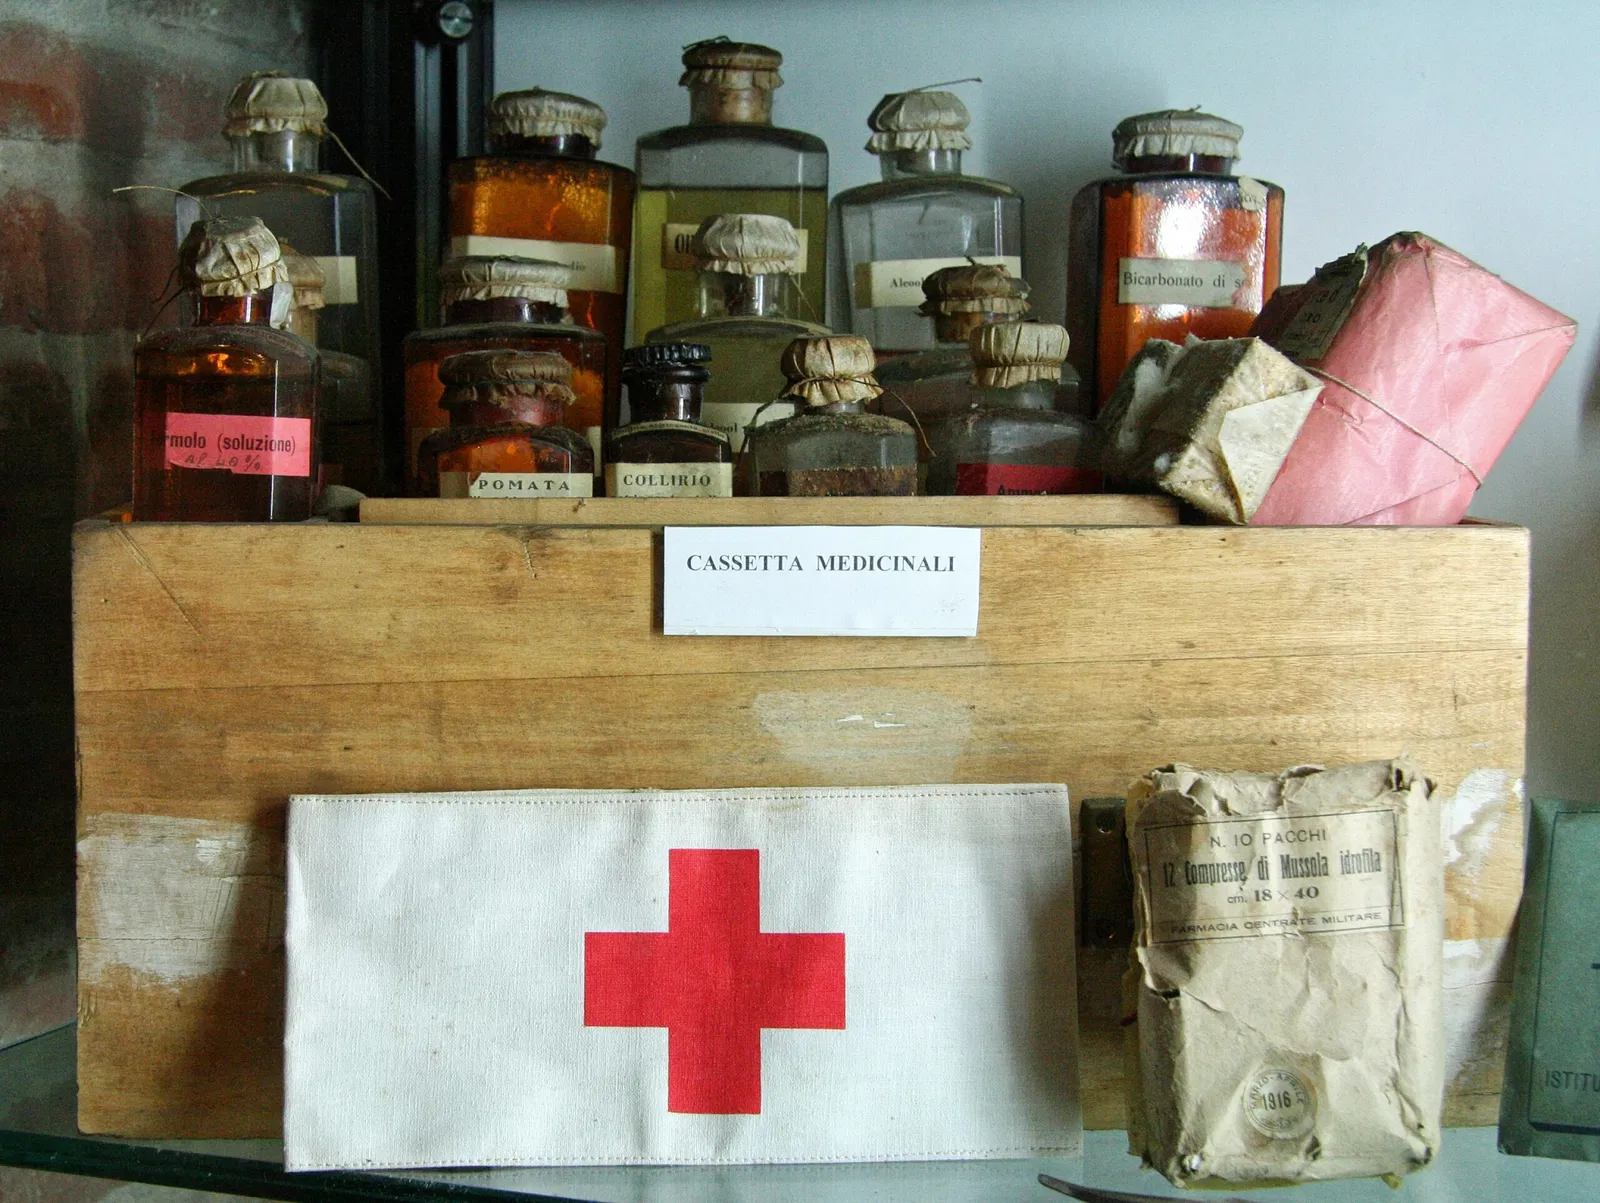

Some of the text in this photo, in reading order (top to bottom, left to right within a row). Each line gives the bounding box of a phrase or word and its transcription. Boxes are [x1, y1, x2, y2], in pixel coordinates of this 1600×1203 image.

[1123, 272, 1203, 287] Bicarbonato
[1213, 275, 1225, 288] di
[217, 433, 296, 456] (soluzione)
[478, 479, 570, 491] POMATA
[623, 474, 711, 487] COLLIRIO
[686, 554, 956, 573] CASSETTA MEDICINALI
[1210, 836, 1227, 847] N.
[1262, 828, 1327, 844] PACCHI
[1163, 847, 1383, 888] 12 Compresse di Mussola idrofila
[1227, 895, 1248, 904] cm.
[1254, 889, 1273, 902] 18
[1294, 885, 1320, 900] 40
[1170, 922, 1239, 933] FARMACIA
[1321, 911, 1383, 925] MILITARE
[1262, 1090, 1292, 1111] 1916
